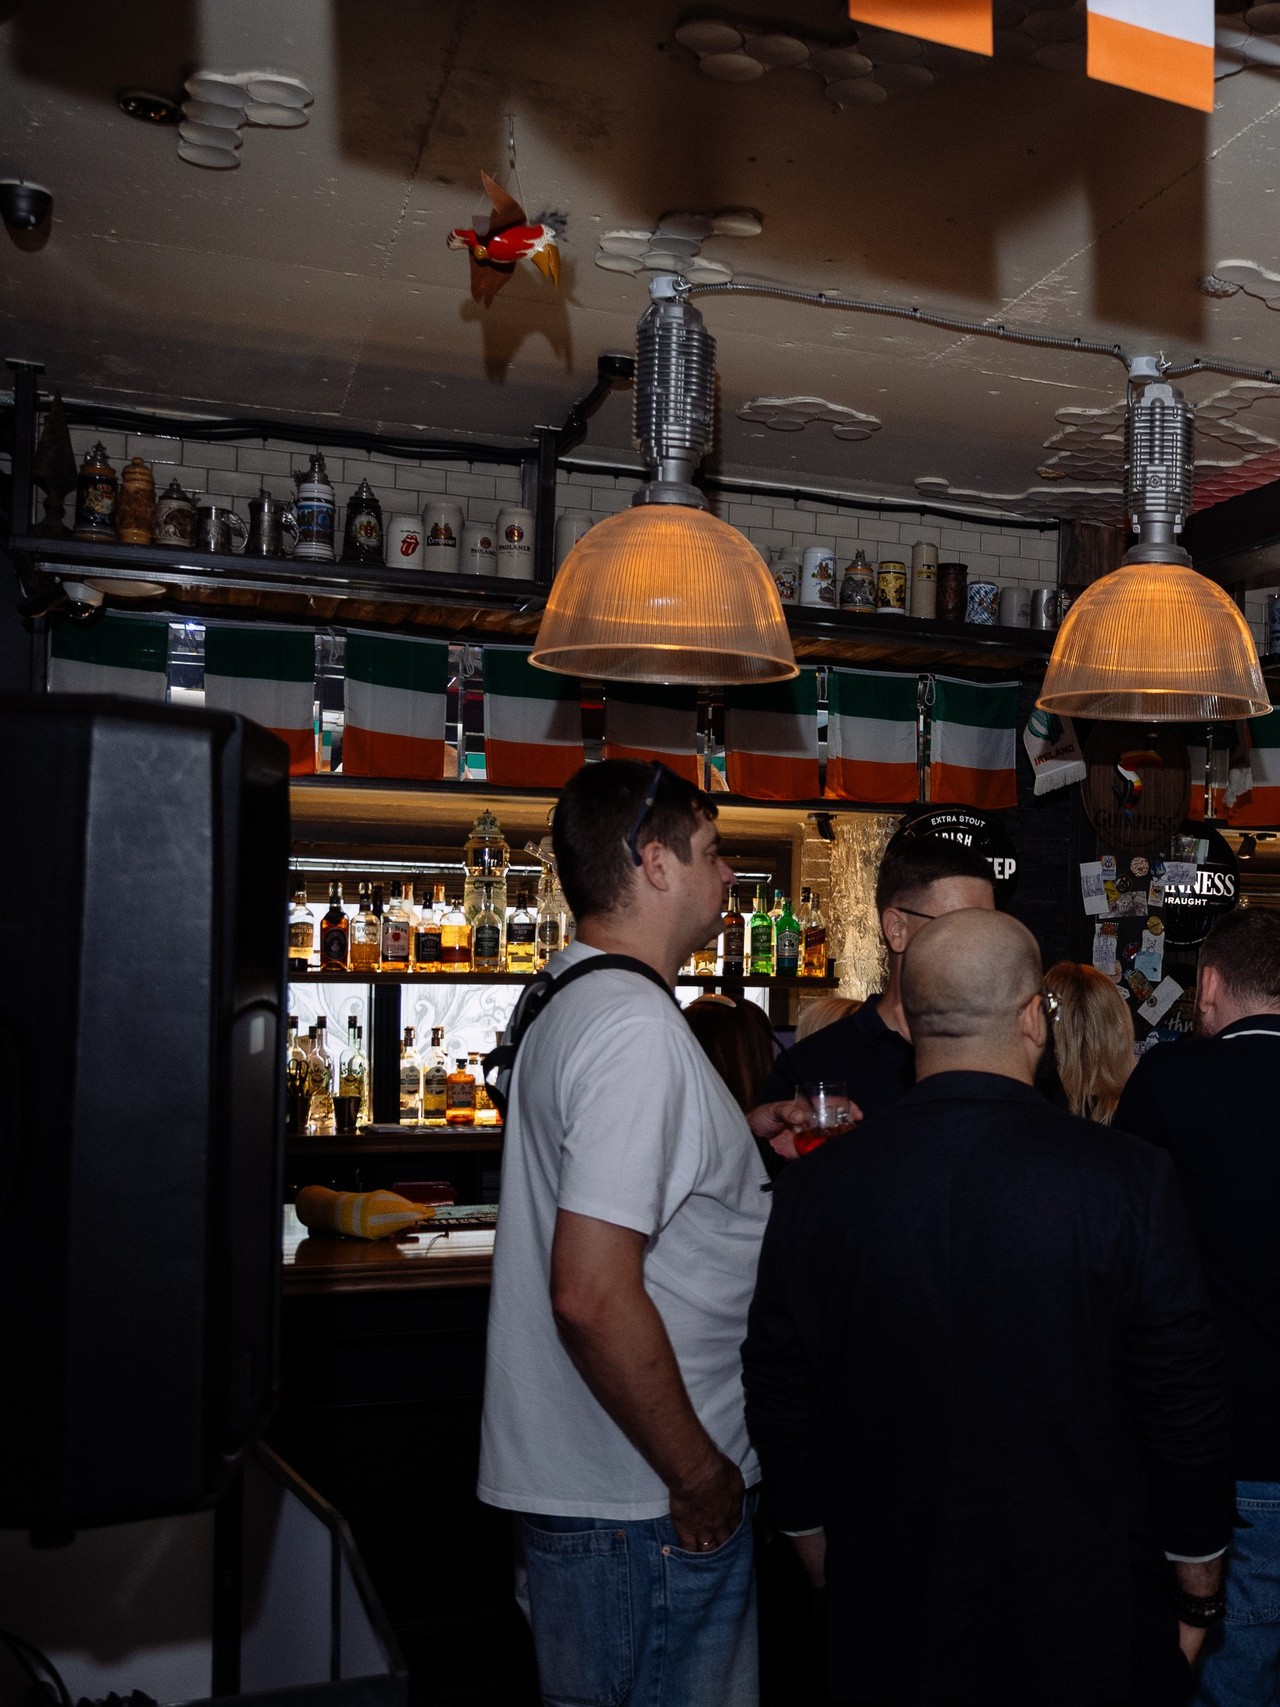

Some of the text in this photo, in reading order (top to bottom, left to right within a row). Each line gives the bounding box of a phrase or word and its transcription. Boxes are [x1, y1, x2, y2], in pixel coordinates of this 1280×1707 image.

[499, 544, 531, 552] PAULANER
[1033, 744, 1076, 766] IRELAND
[931, 815, 986, 827] EXTRA STOUT
[1096, 809, 1177, 831] GUINNESS
[985, 857, 1017, 880] EP
